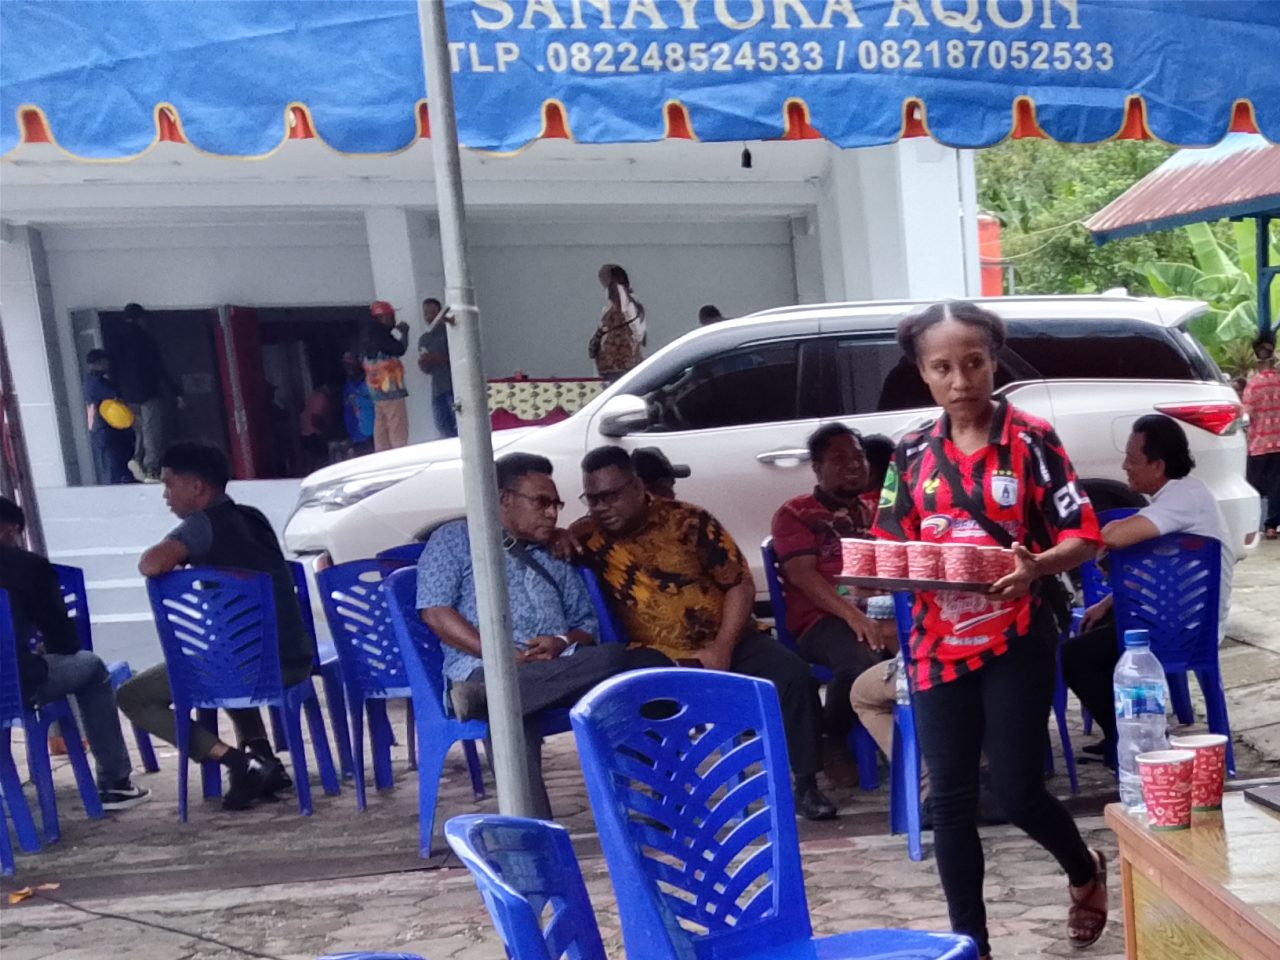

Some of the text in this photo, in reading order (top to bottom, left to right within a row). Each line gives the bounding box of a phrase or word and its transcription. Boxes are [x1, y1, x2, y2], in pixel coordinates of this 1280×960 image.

[447, 41, 519, 72] TLP
[835, 40, 845, 70] /
[858, 39, 1114, 71] 082187052533
